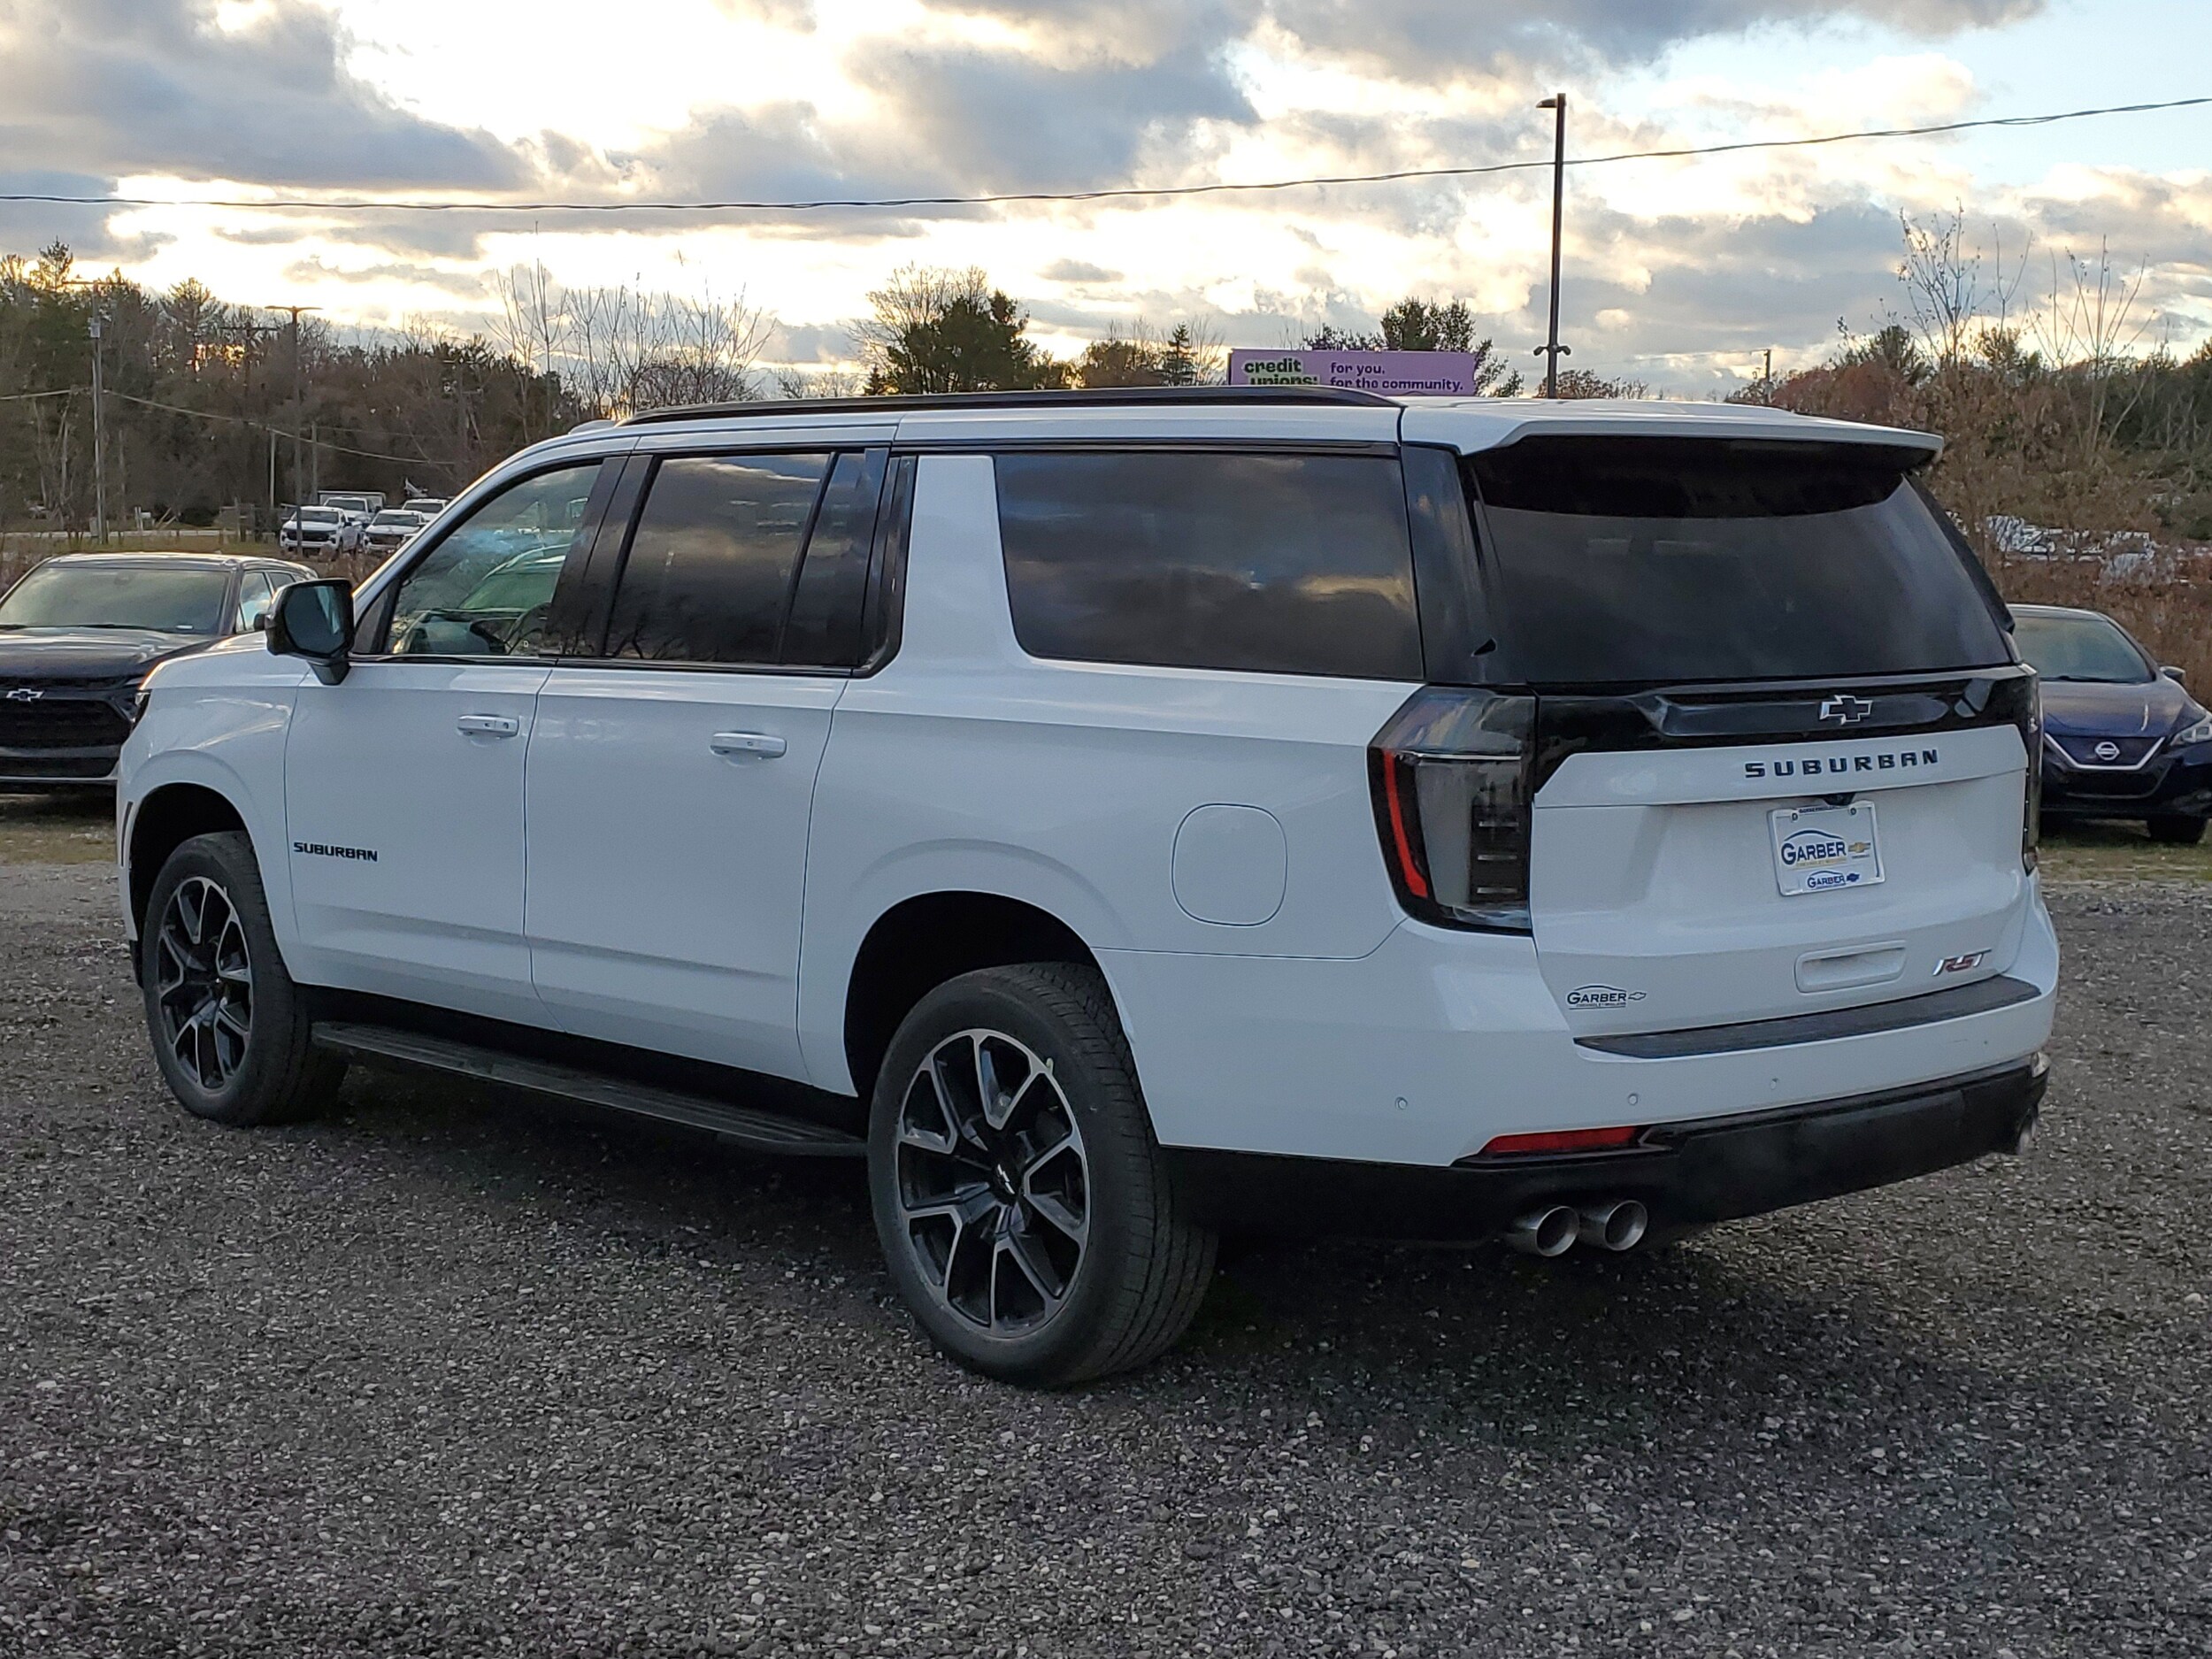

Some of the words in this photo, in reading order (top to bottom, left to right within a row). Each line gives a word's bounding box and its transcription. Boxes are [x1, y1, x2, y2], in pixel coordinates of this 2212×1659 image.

[1244, 357, 1302, 373] credit
[1331, 363, 1352, 373] for
[1356, 365, 1385, 376] you.
[1330, 377, 1352, 388] for
[1356, 378, 1379, 388] the
[1382, 379, 1463, 392] community.
[1745, 749, 1938, 778] SUBURBAN
[294, 841, 378, 862] SUBURBAN
[1781, 841, 1847, 865] GARBER
[1807, 875, 1846, 888] GARBER
[1567, 992, 1626, 1004] GARBER
